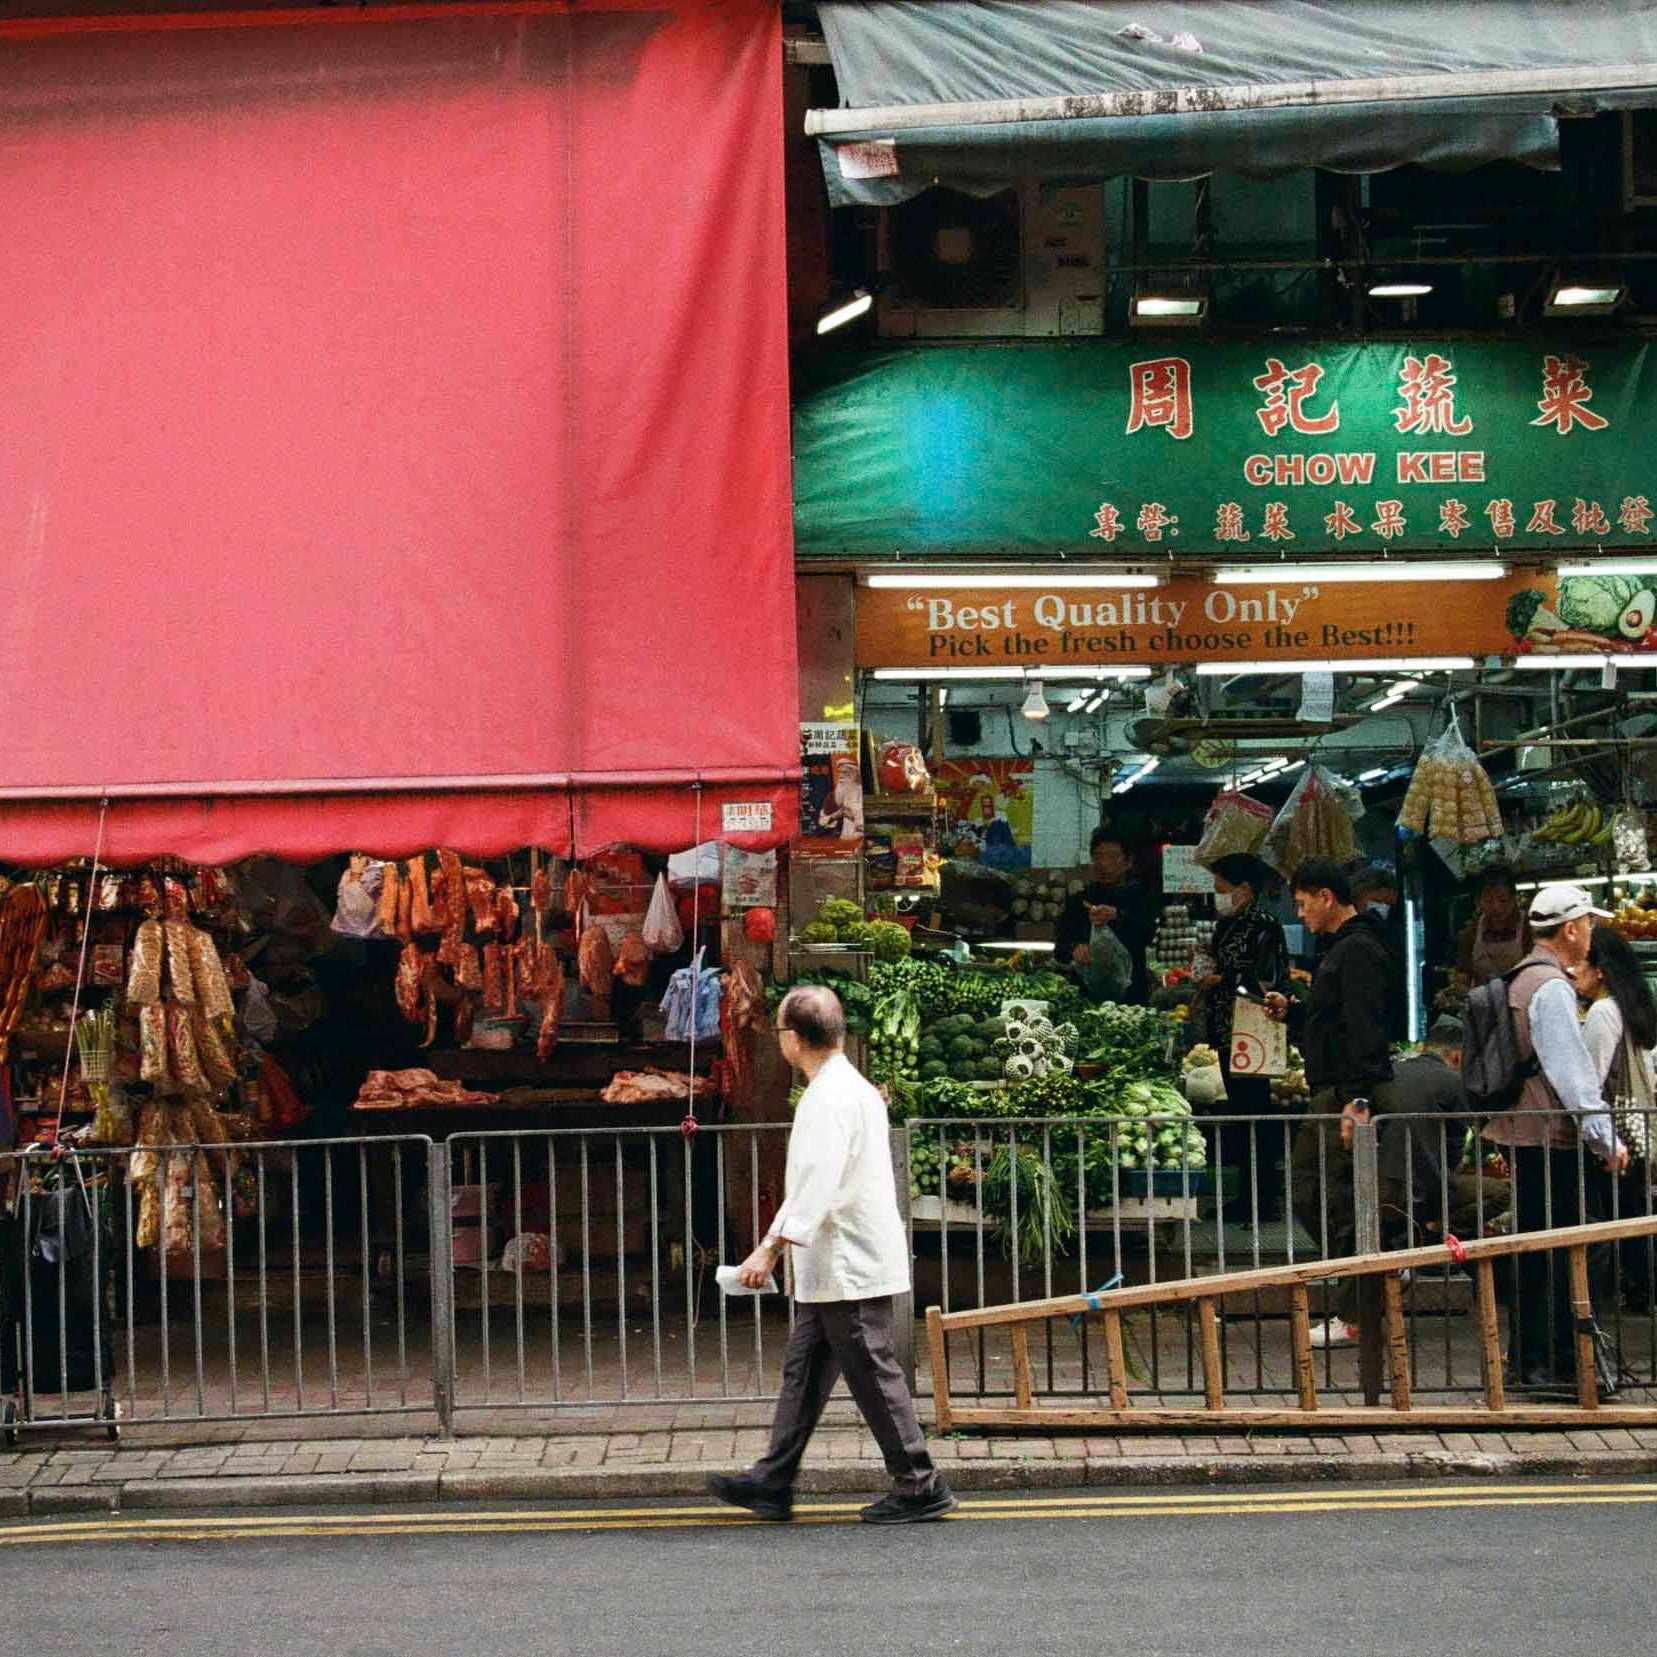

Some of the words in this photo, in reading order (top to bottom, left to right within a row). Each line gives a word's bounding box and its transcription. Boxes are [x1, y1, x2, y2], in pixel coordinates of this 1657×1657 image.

[1125, 354, 1611, 439] 周記蔬菜
[1244, 452, 1376, 486] CHOW
[1397, 451, 1486, 484] KEE
[1215, 502, 1295, 542] 蔬菜
[1323, 500, 1406, 540] 水果
[1438, 496, 1655, 540] 零售及批發
[1034, 592, 1188, 632] Quality
[929, 632, 992, 657] Pick
[1003, 634, 1049, 656] the
[1060, 630, 1135, 654] fresh
[1149, 627, 1252, 651] choose
[1264, 624, 1310, 648] the
[1321, 622, 1416, 646] Best!!!
